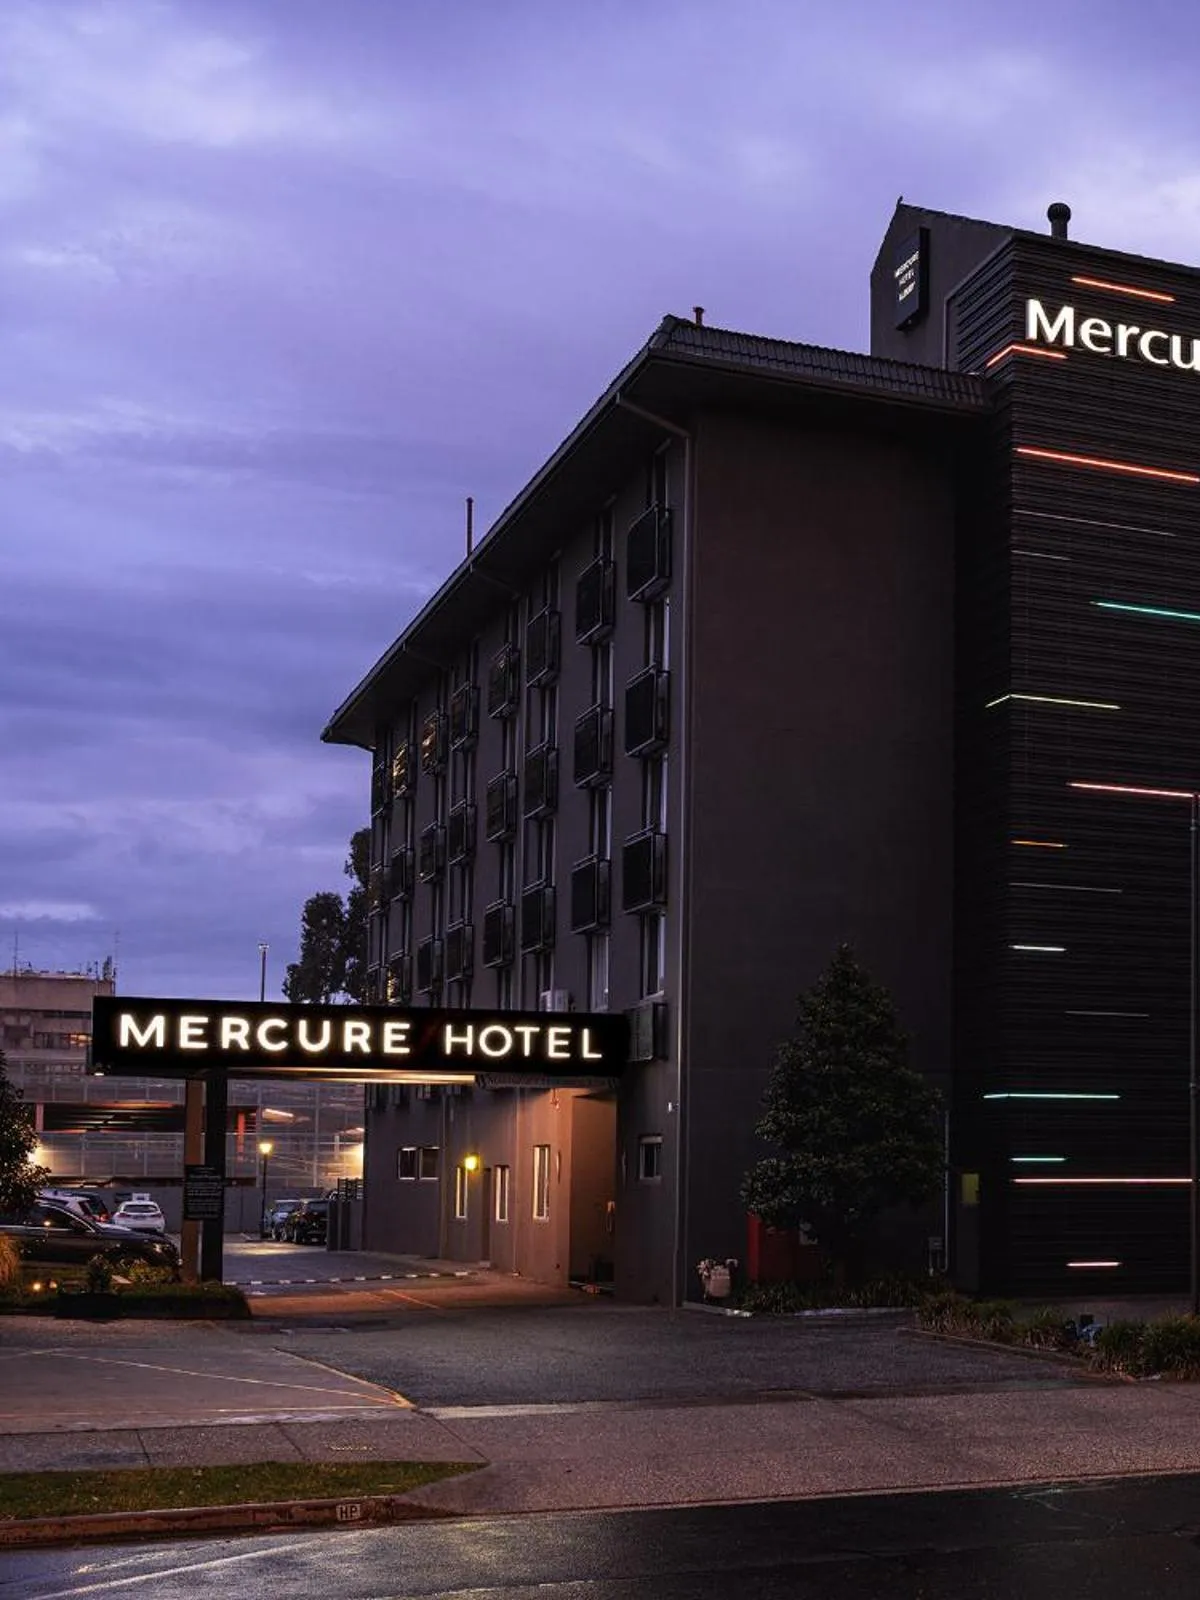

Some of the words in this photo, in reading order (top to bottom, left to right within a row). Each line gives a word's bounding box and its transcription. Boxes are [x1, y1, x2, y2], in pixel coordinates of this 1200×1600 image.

[119, 1013, 411, 1055] MERCURE
[444, 1023, 603, 1059] HOTEL
[340, 1504, 358, 1519] HP
